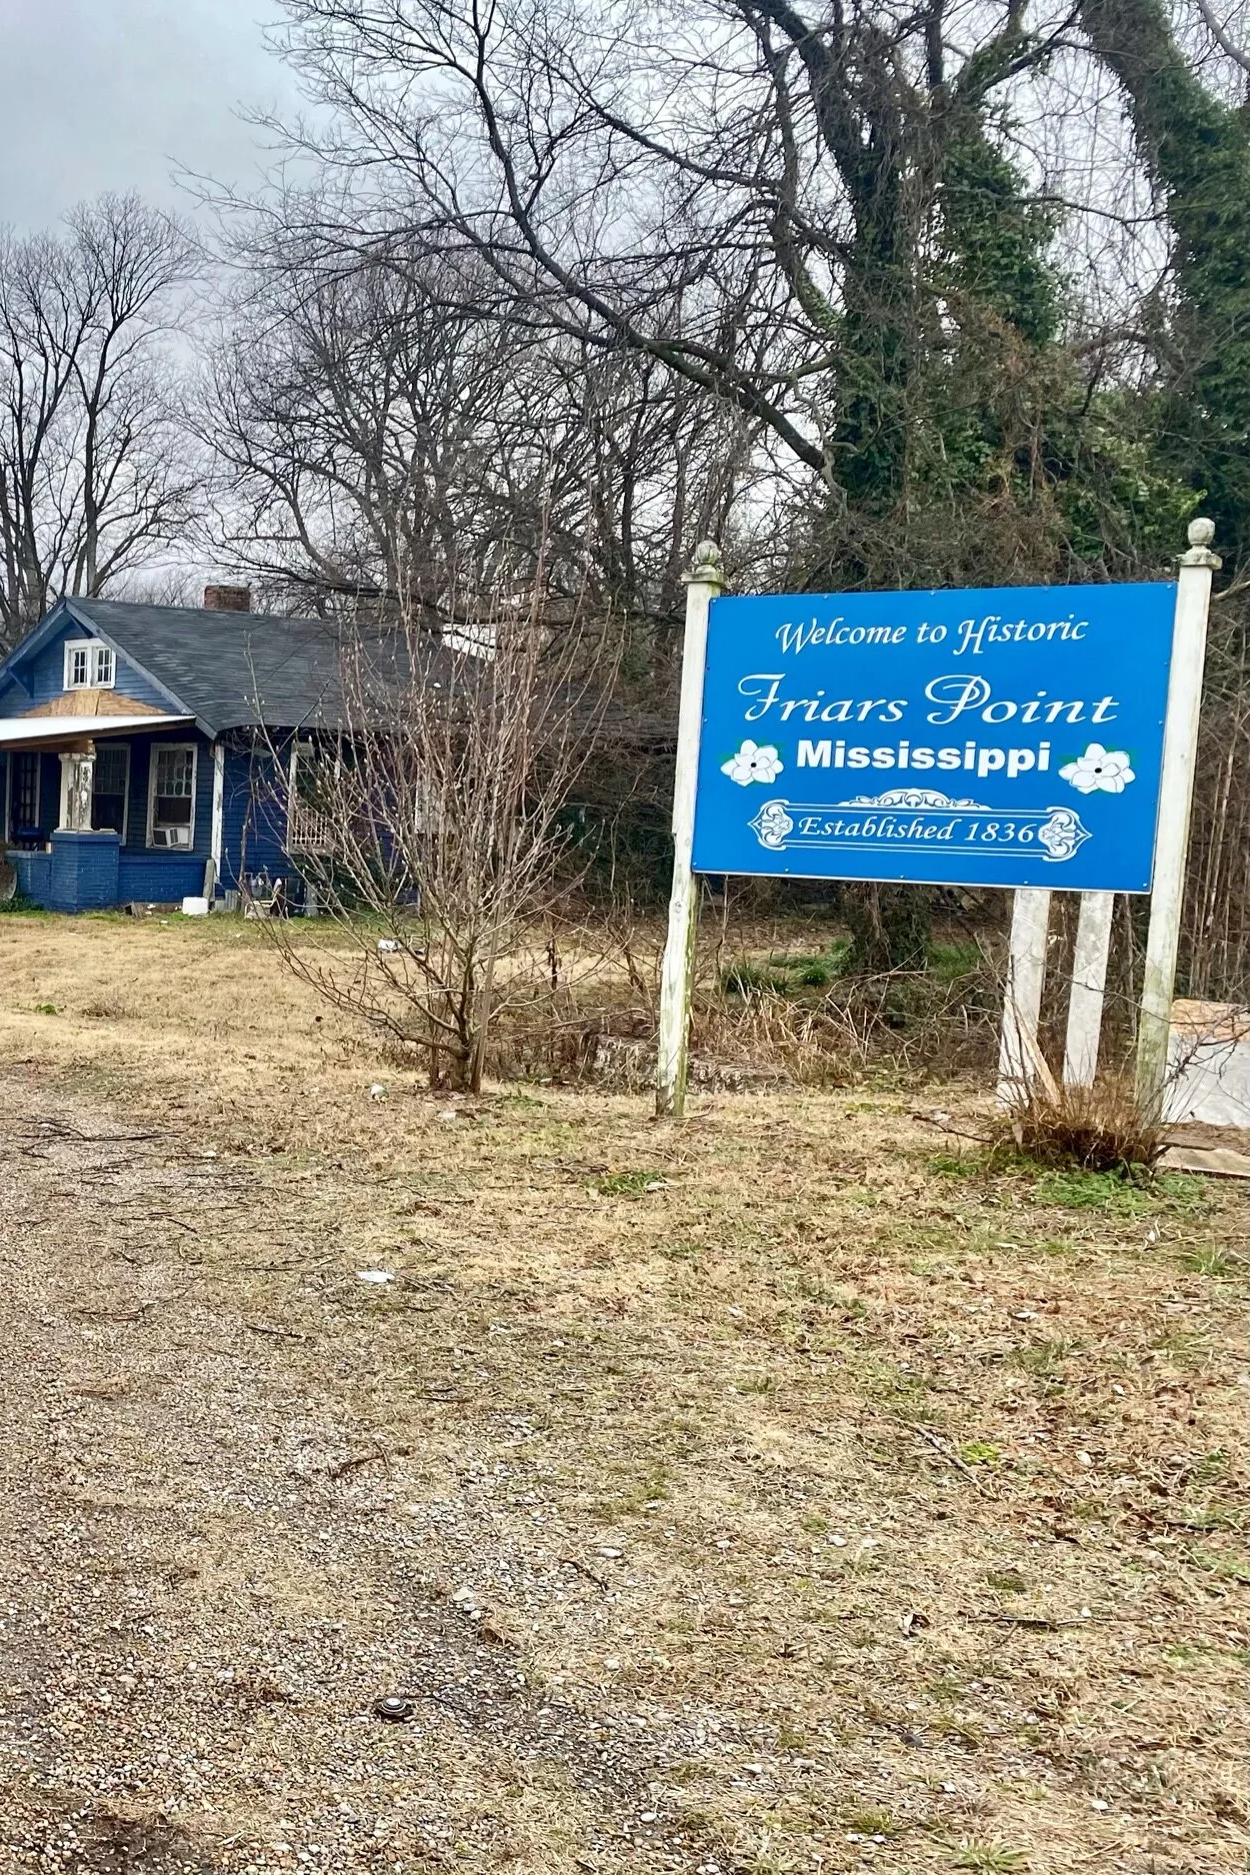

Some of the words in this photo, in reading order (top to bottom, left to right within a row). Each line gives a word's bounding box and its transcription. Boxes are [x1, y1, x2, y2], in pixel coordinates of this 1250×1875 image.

[775, 617, 907, 655] Welcome
[916, 622, 948, 643] to
[952, 613, 1089, 655] Historic
[737, 673, 908, 723] Friars
[924, 674, 1119, 725] Point
[796, 739, 1051, 778] Mississippi
[797, 816, 960, 842] Established
[964, 821, 1036, 845] 1836
